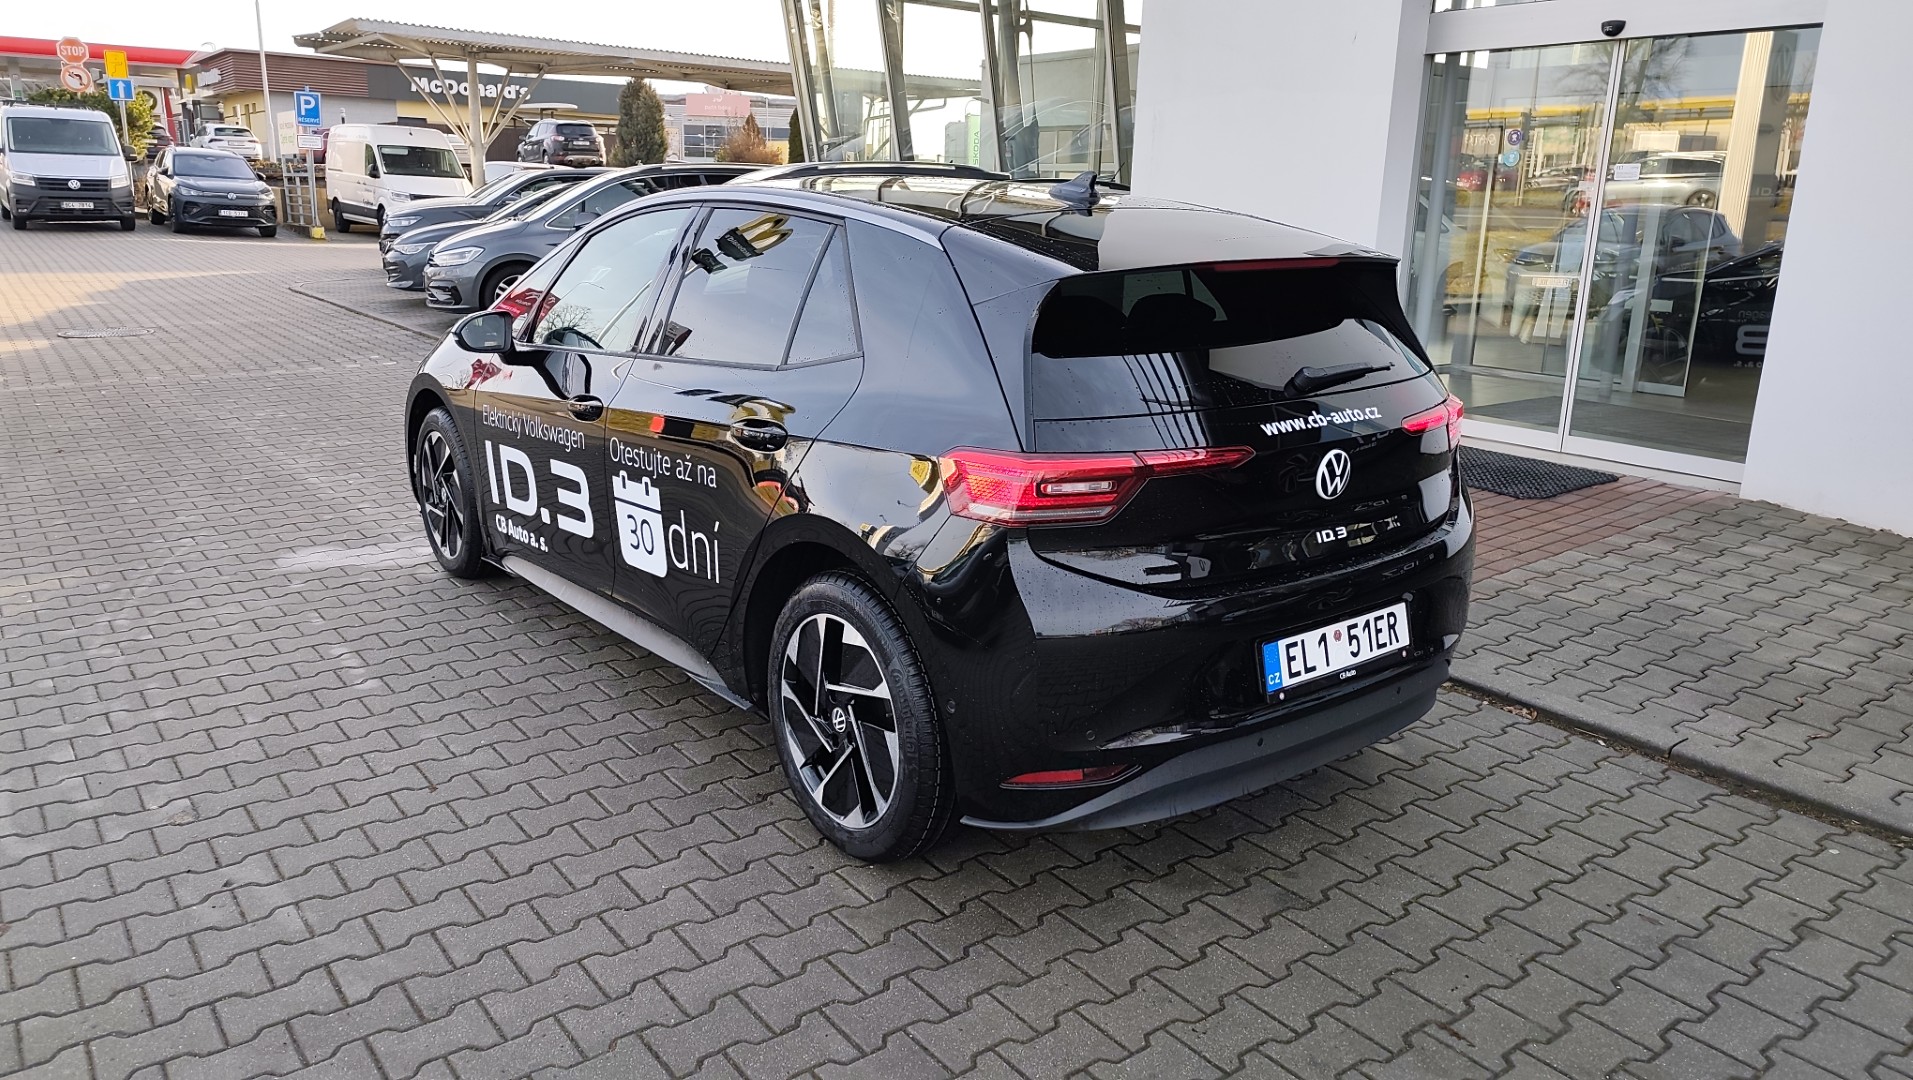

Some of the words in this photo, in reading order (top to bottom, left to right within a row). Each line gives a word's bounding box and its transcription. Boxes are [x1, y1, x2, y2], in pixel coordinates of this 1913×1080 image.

[60, 45, 85, 57] STOP
[300, 95, 316, 116] P
[410, 76, 531, 100] McDonald's
[482, 404, 522, 439] Elektrický
[523, 413, 586, 453] Volkswagen
[1260, 404, 1383, 437] www.cb-auto.cz
[609, 437, 671, 479] Otestujte
[675, 452, 693, 482] až
[697, 463, 718, 488] na
[484, 440, 595, 539] ID.3
[495, 513, 507, 534] CB
[508, 518, 529, 544] Auto
[529, 532, 539, 549] a.
[540, 536, 549, 553] s.
[626, 513, 655, 556] 30
[668, 509, 721, 584] dní
[1284, 633, 1332, 679] EL1
[1346, 611, 1400, 658] 51ER
[1268, 672, 1281, 686] CZ
